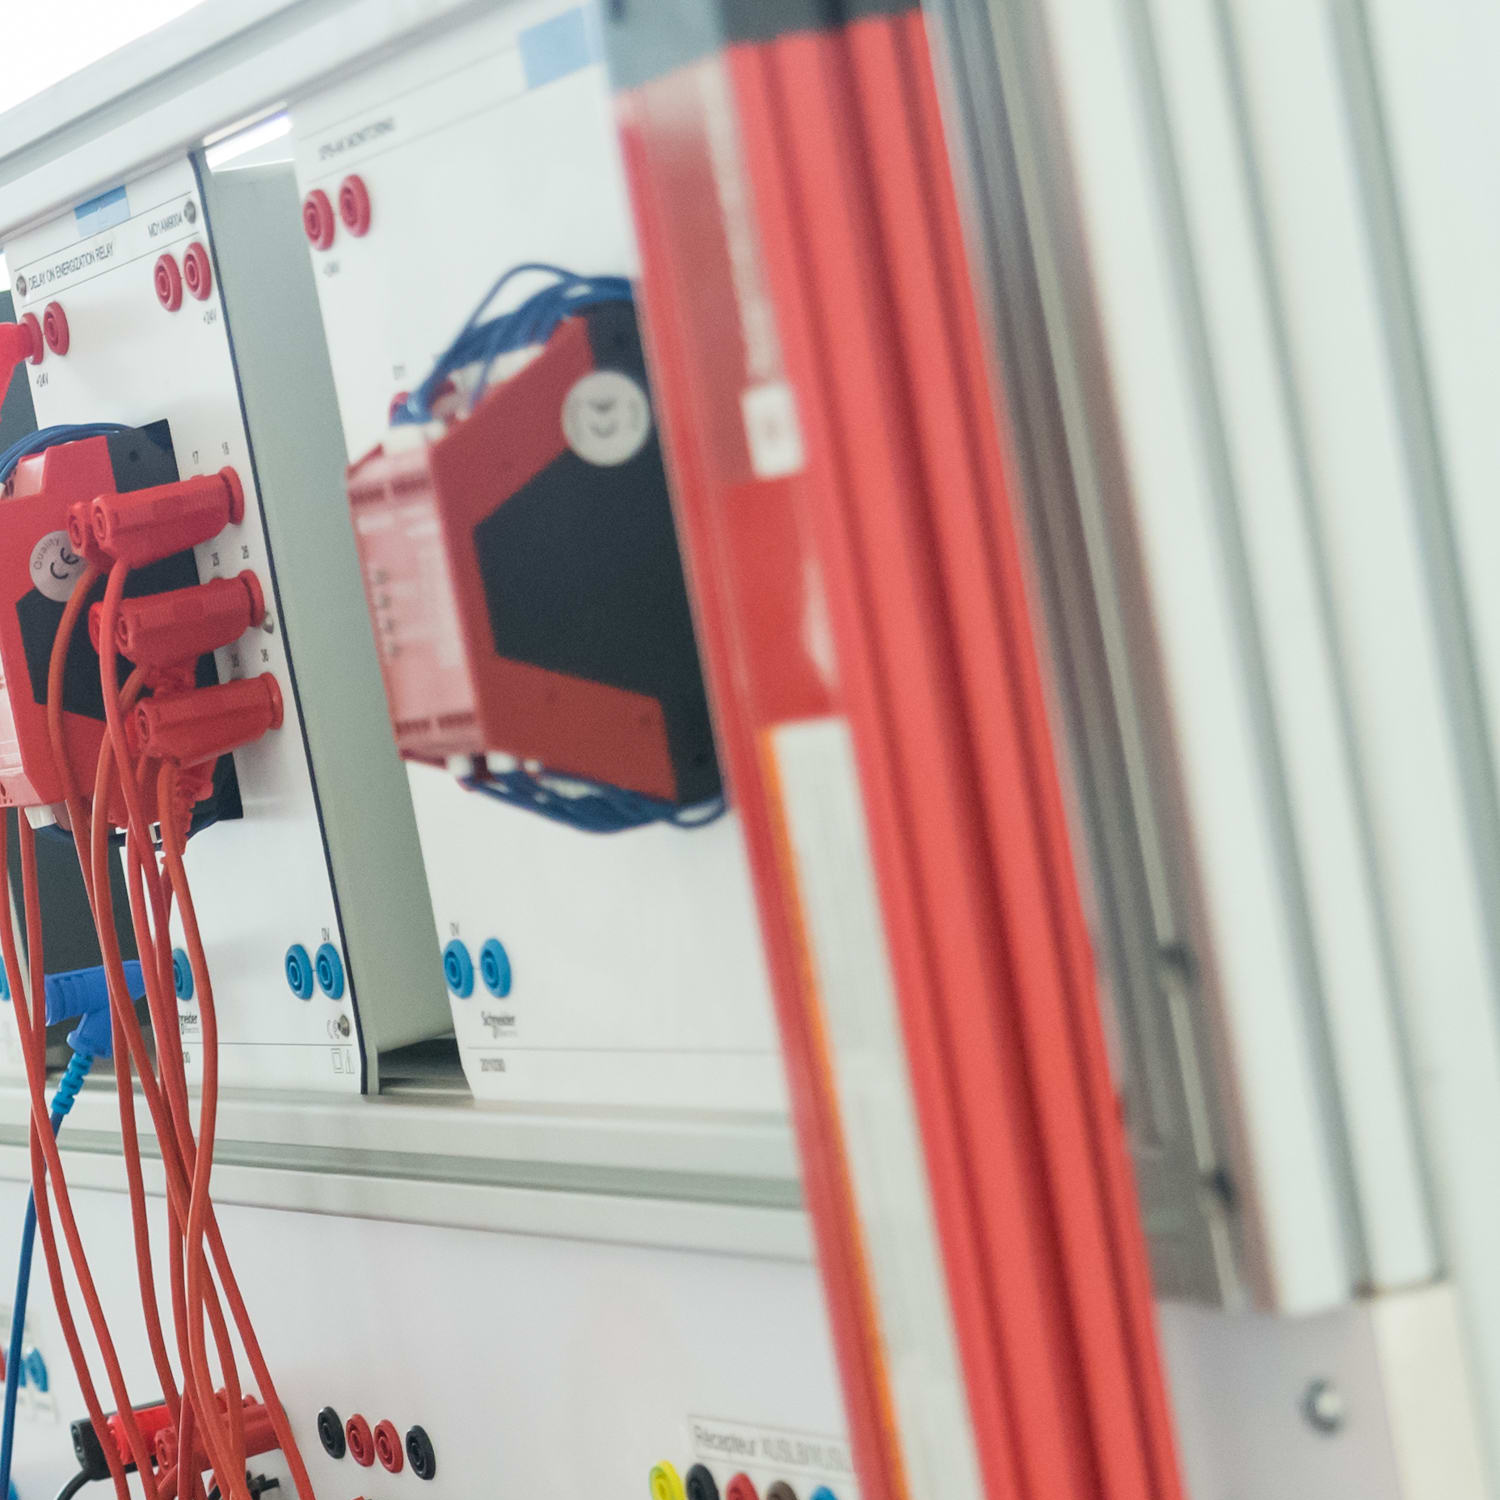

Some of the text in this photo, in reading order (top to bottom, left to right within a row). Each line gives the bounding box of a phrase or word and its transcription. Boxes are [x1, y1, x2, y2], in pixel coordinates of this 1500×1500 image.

[28, 240, 115, 291] DELAY ON ENERGIZATION RELAY
[32, 537, 61, 571] Quality
